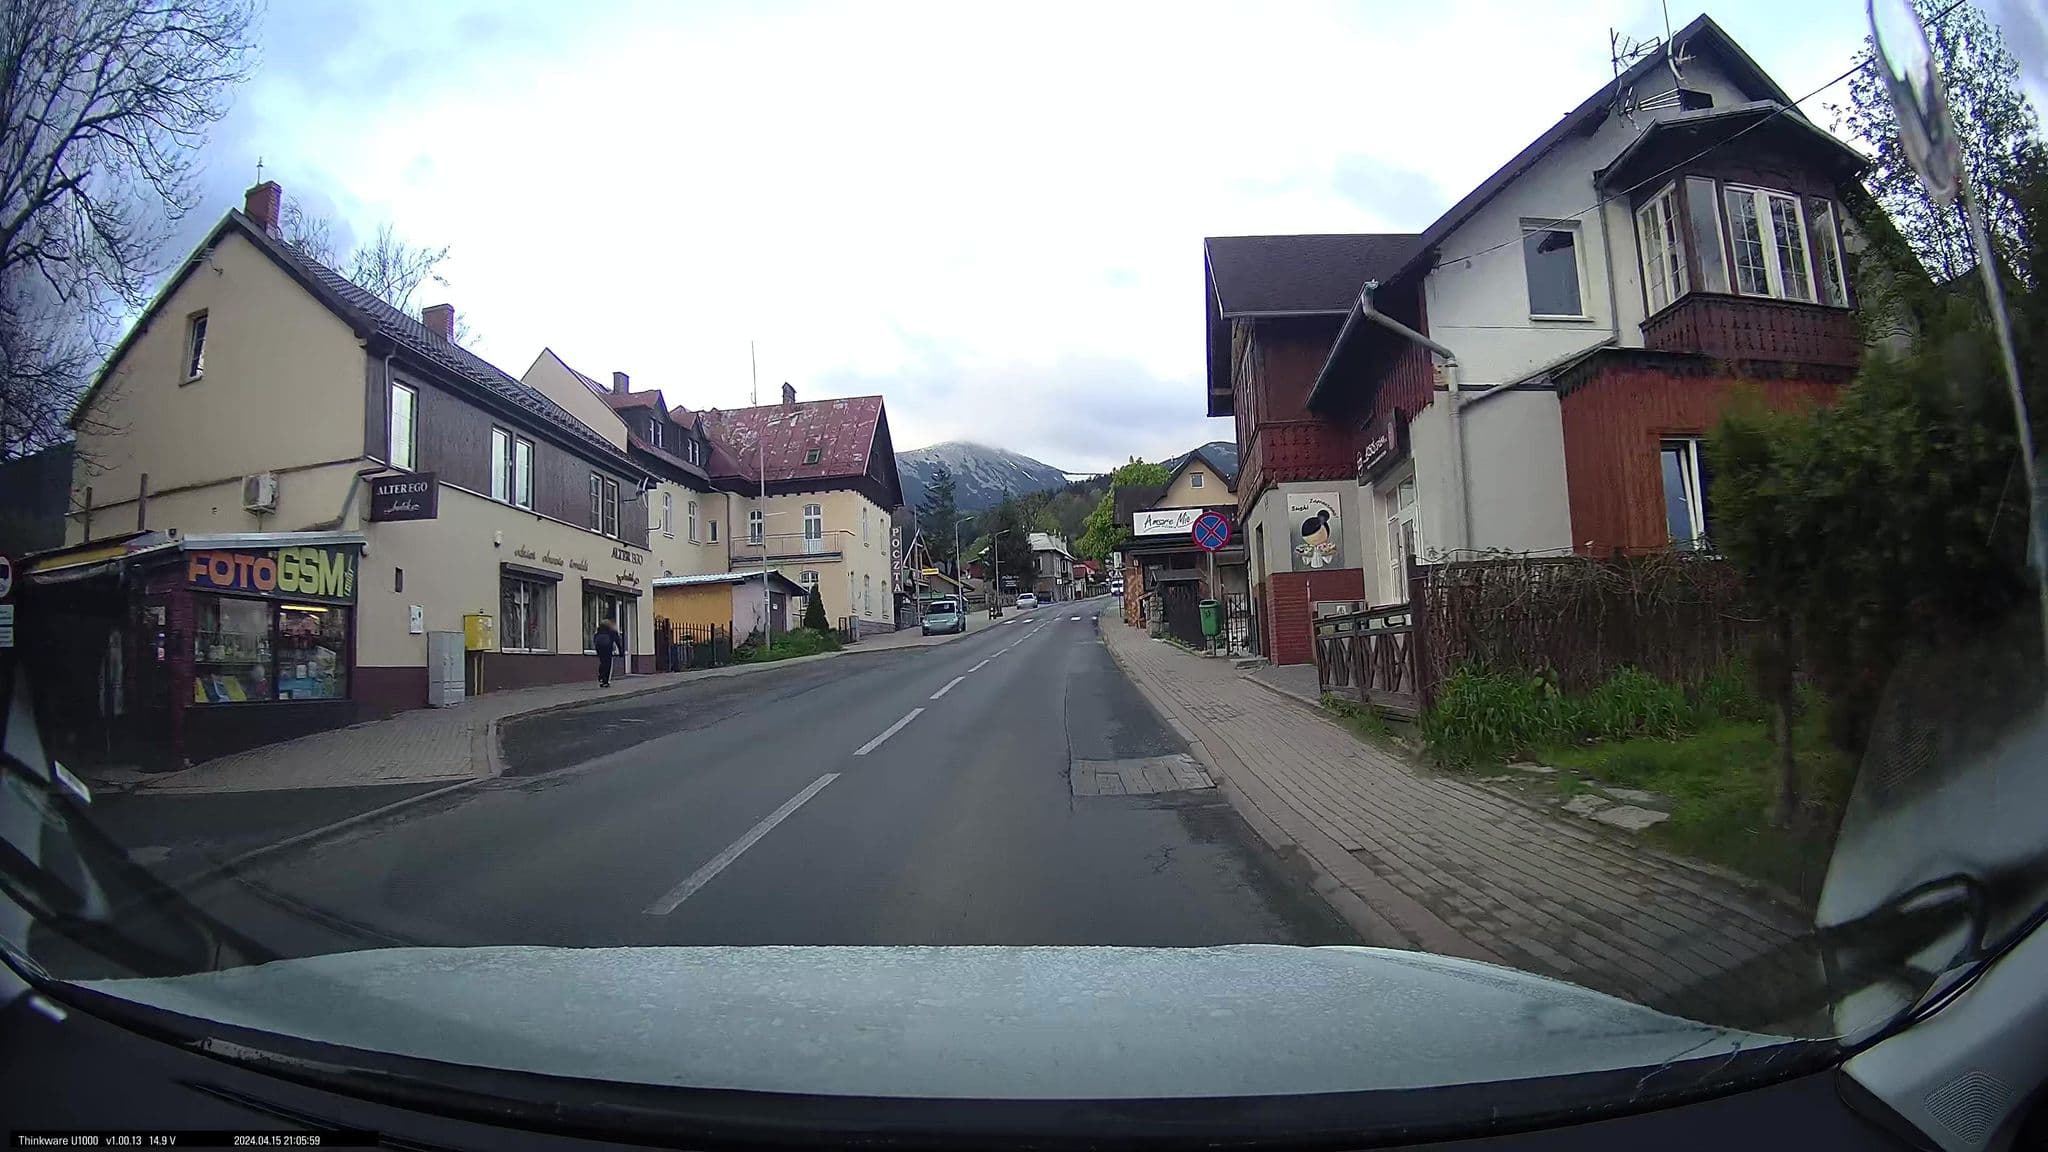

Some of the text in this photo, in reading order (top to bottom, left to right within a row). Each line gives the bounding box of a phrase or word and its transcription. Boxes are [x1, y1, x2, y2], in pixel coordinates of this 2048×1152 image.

[376, 481, 428, 495] ALTER EGO
[611, 547, 631, 563] ALTER
[891, 527, 901, 592] POCZTA
[187, 551, 278, 592] FOTO
[277, 547, 345, 598] GSM
